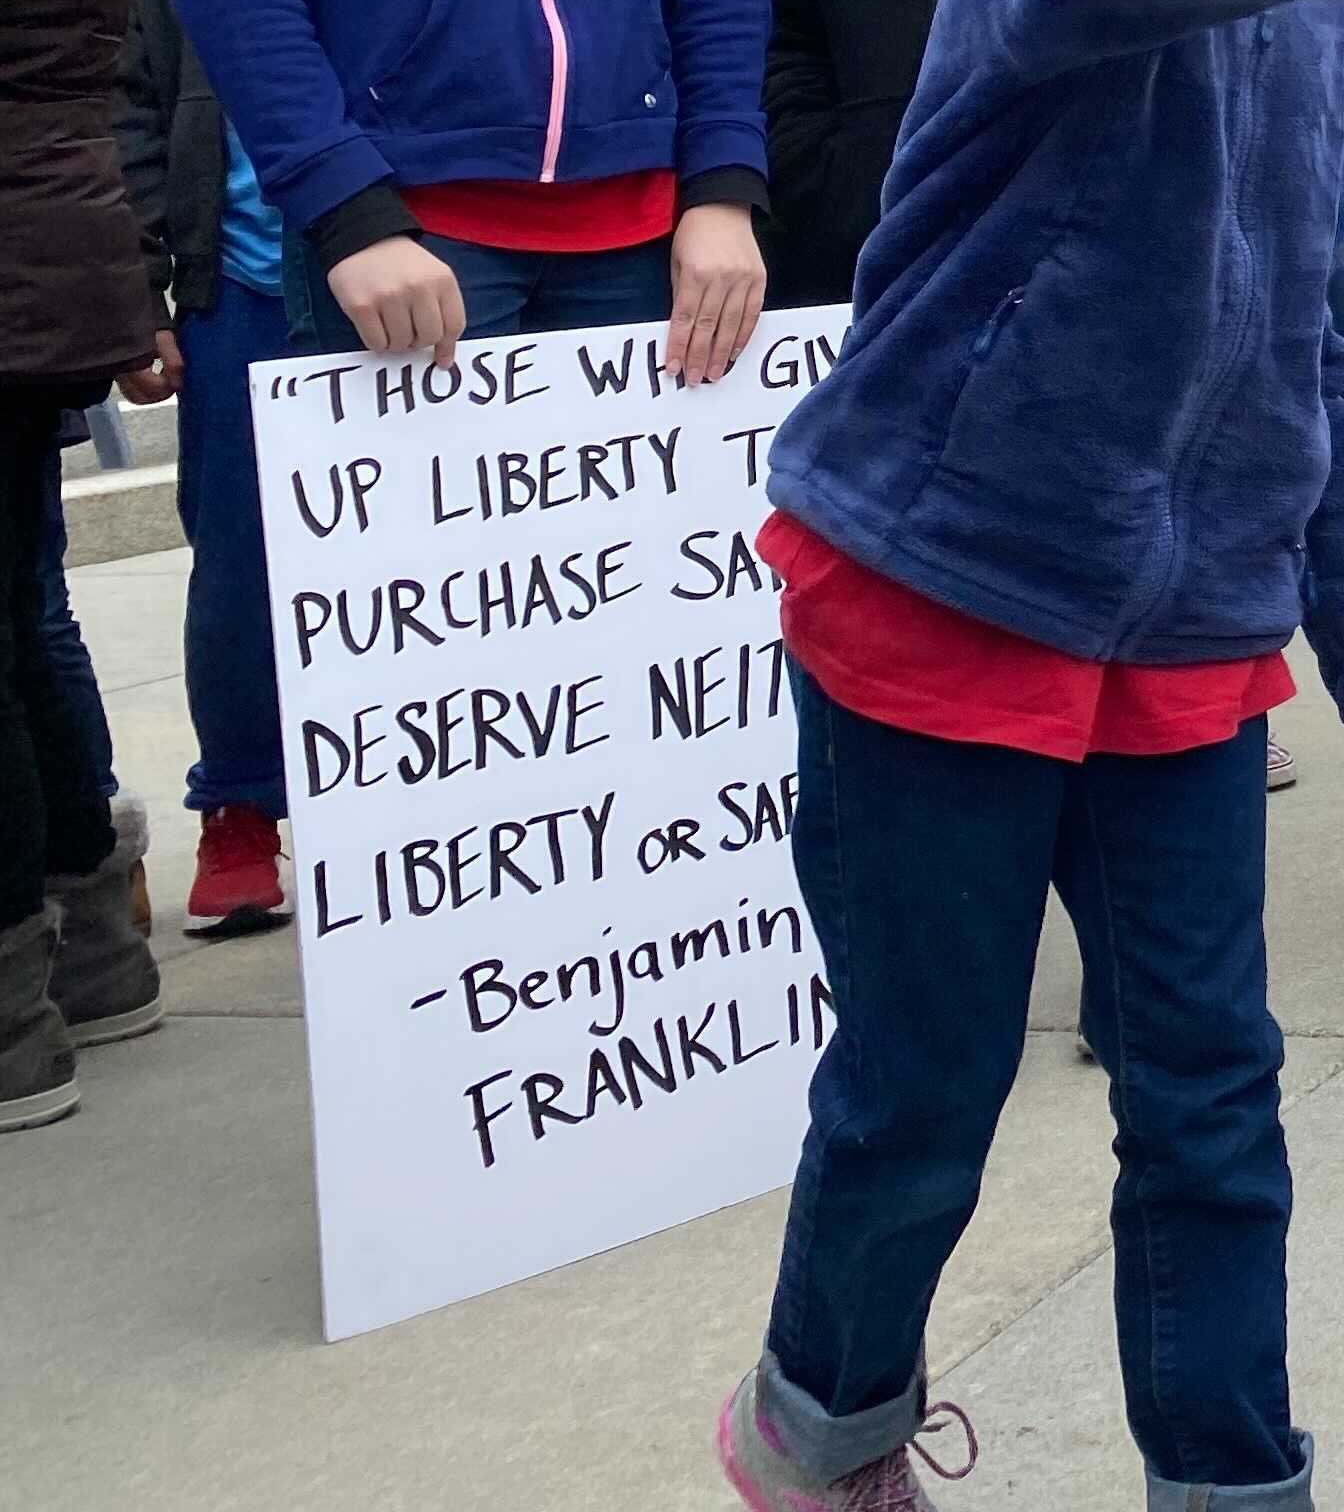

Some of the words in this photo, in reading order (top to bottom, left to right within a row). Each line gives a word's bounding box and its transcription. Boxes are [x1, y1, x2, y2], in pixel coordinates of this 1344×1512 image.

[577, 337, 737, 398] WH
[291, 456, 382, 538] UP
[432, 426, 682, 525] LIBERTY
[291, 540, 643, 669] PURCHASE
[301, 674, 611, 798] DESERVE
[313, 792, 616, 938] LIBERTY
